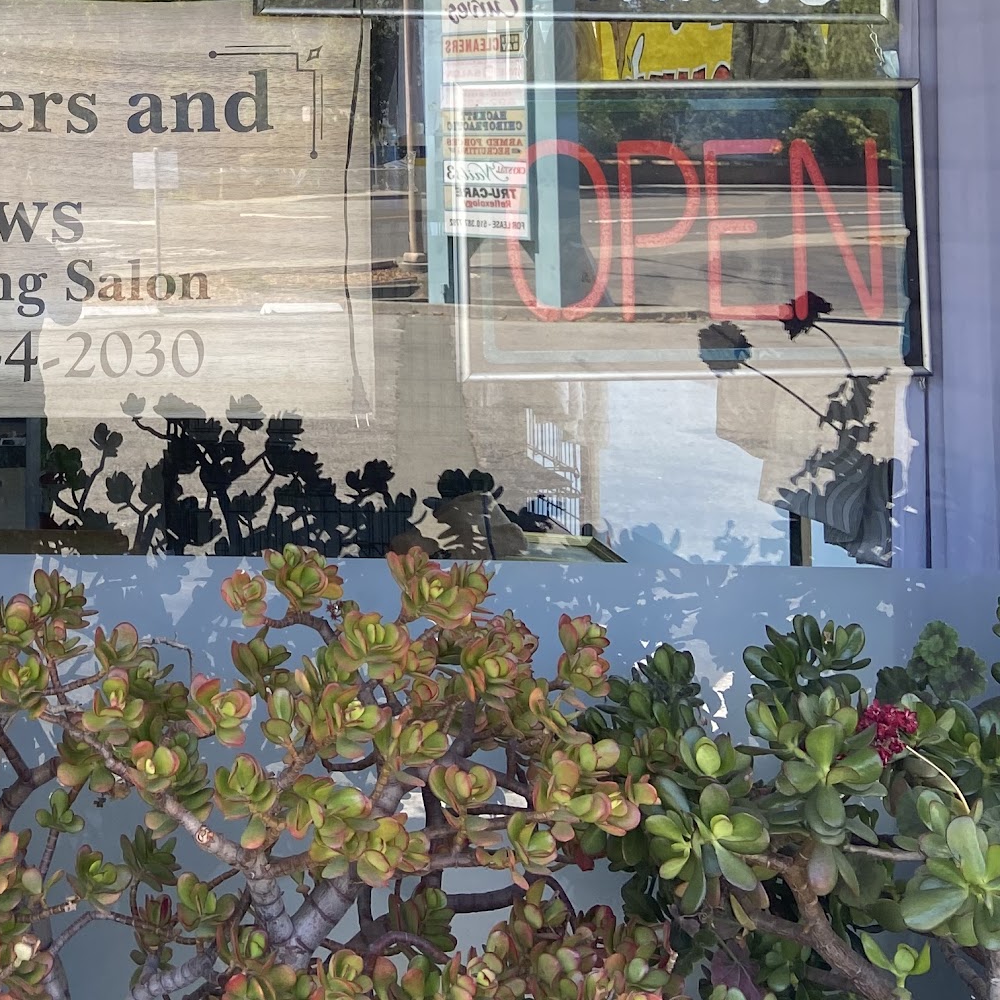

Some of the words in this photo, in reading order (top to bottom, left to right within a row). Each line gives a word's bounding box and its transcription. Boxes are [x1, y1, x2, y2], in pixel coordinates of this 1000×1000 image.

[127, 70, 275, 134] and
[506, 138, 885, 323] OPEN
[66, 259, 211, 301] Salon
